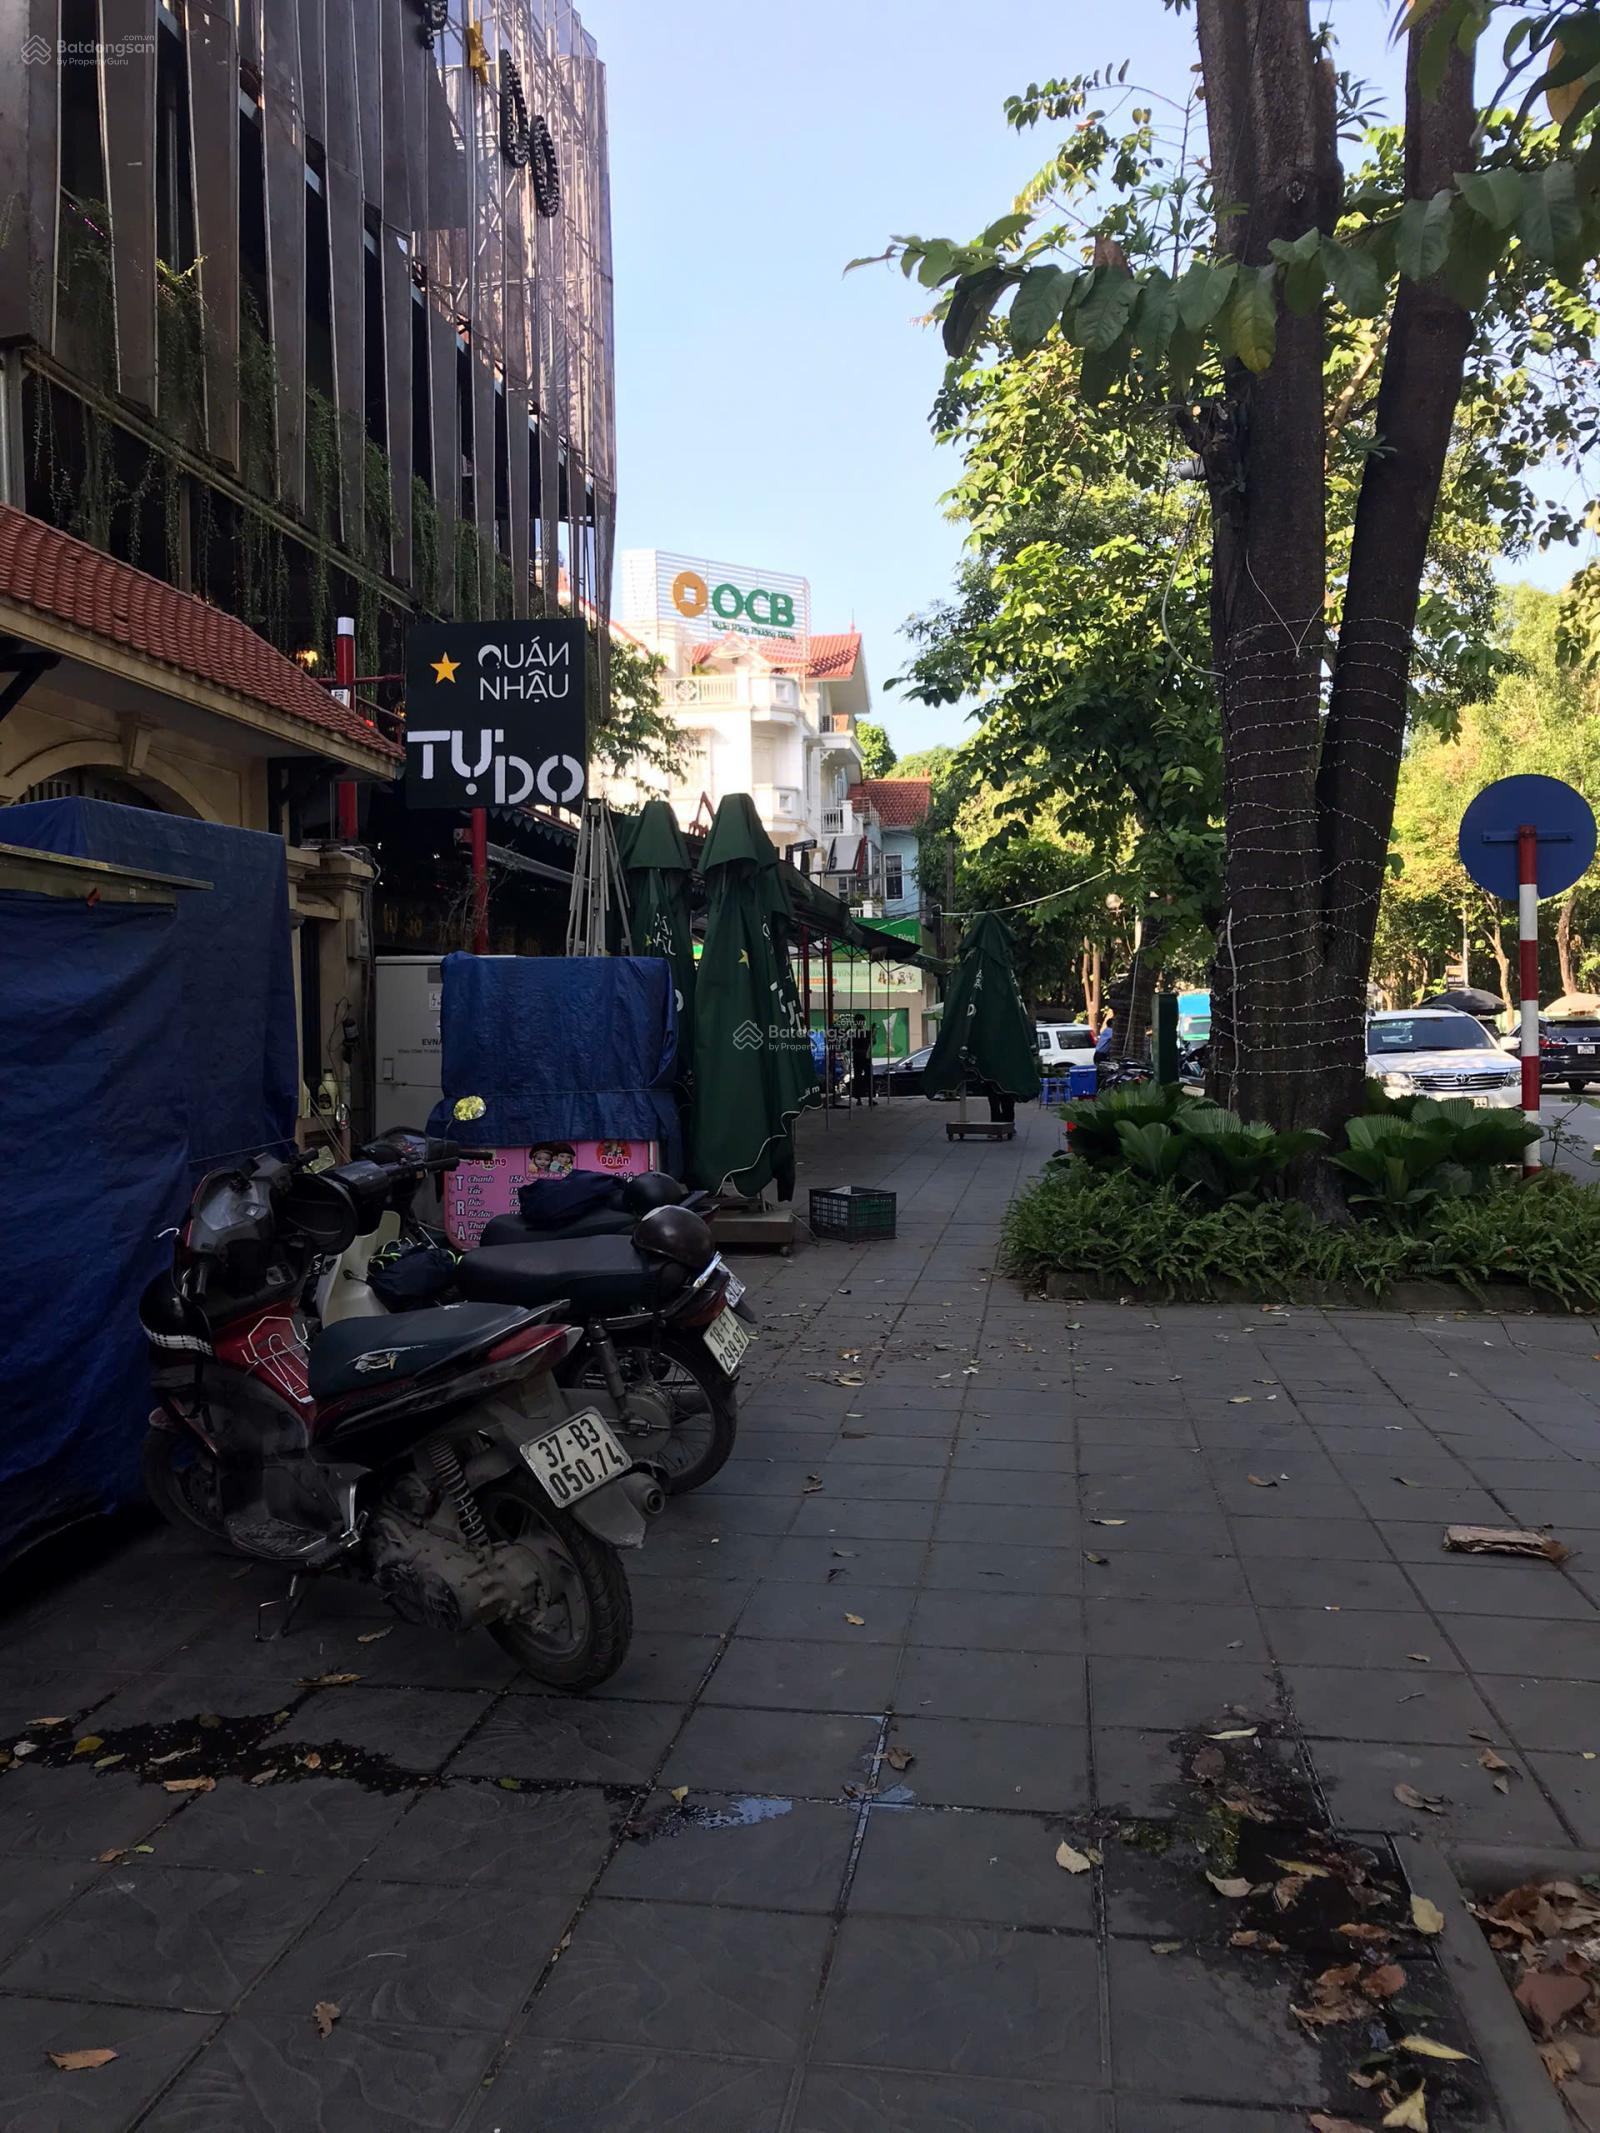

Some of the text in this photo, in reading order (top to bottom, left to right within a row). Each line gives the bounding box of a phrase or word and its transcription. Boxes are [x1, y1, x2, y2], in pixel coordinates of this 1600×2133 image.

[711, 583, 796, 628] OCB
[477, 635, 570, 669] QUÁN
[479, 669, 570, 702] NHẬU
[494, 754, 585, 804] DO
[467, 1175, 494, 1184] Chanh
[537, 1418, 601, 1468] 37-B3
[548, 1442, 625, 1500] 050.74
